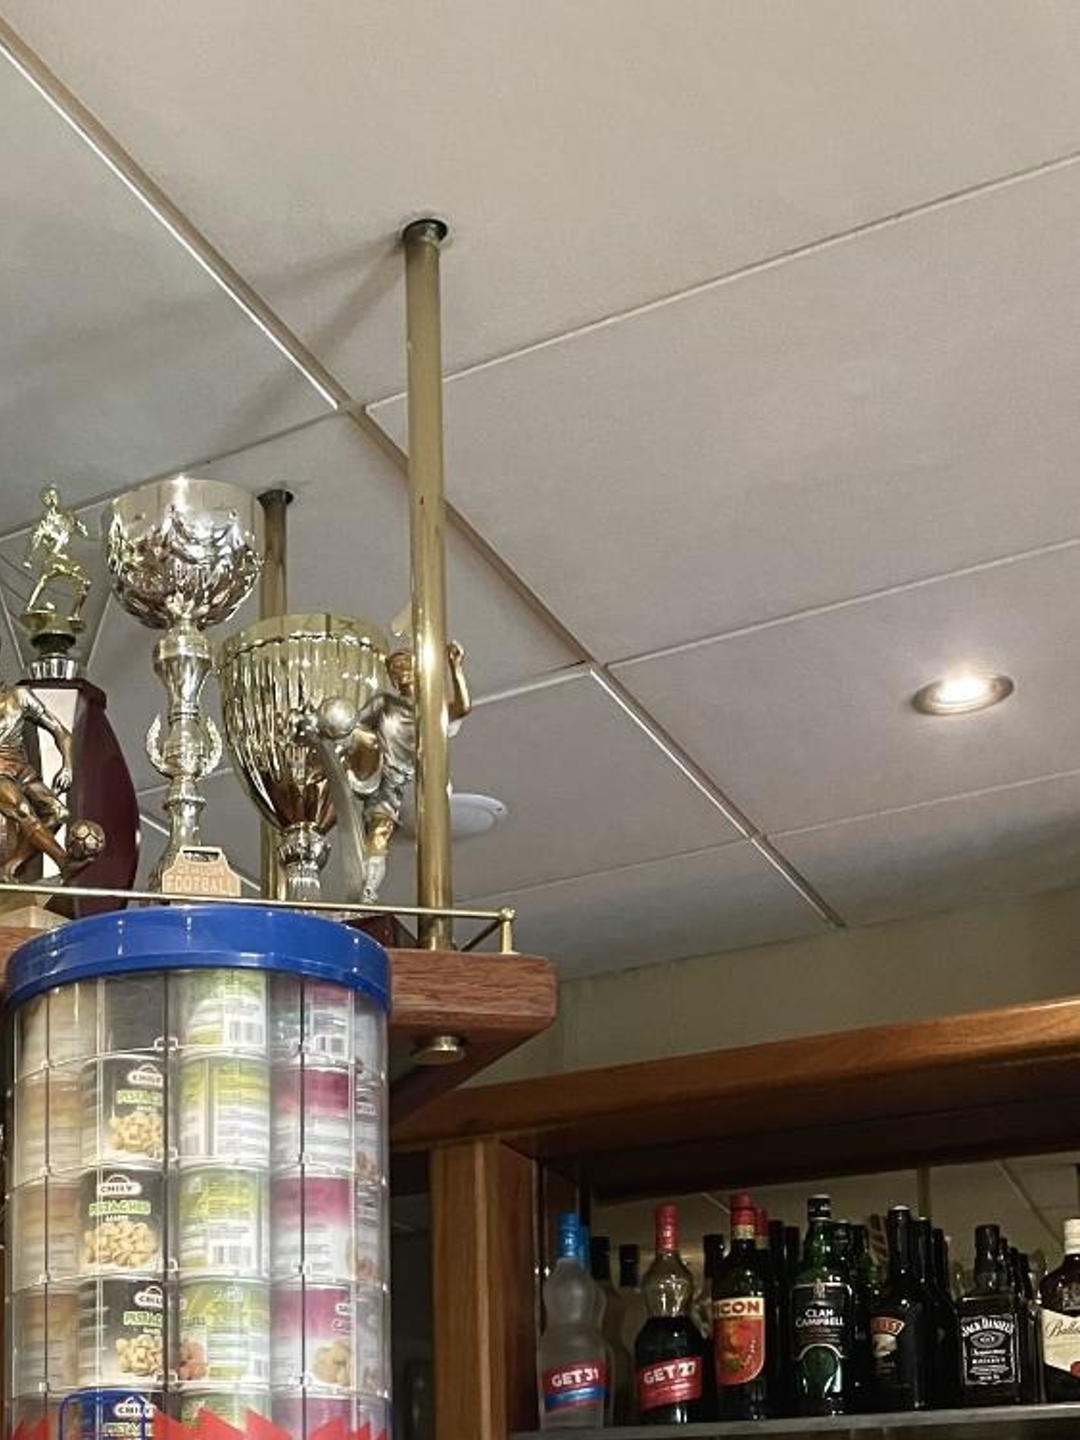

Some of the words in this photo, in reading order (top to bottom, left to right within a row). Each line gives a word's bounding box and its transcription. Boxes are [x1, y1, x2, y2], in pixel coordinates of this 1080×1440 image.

[714, 1300, 761, 1315] ICON
[551, 1371, 585, 1388] GET
[643, 1364, 677, 1385] GET
